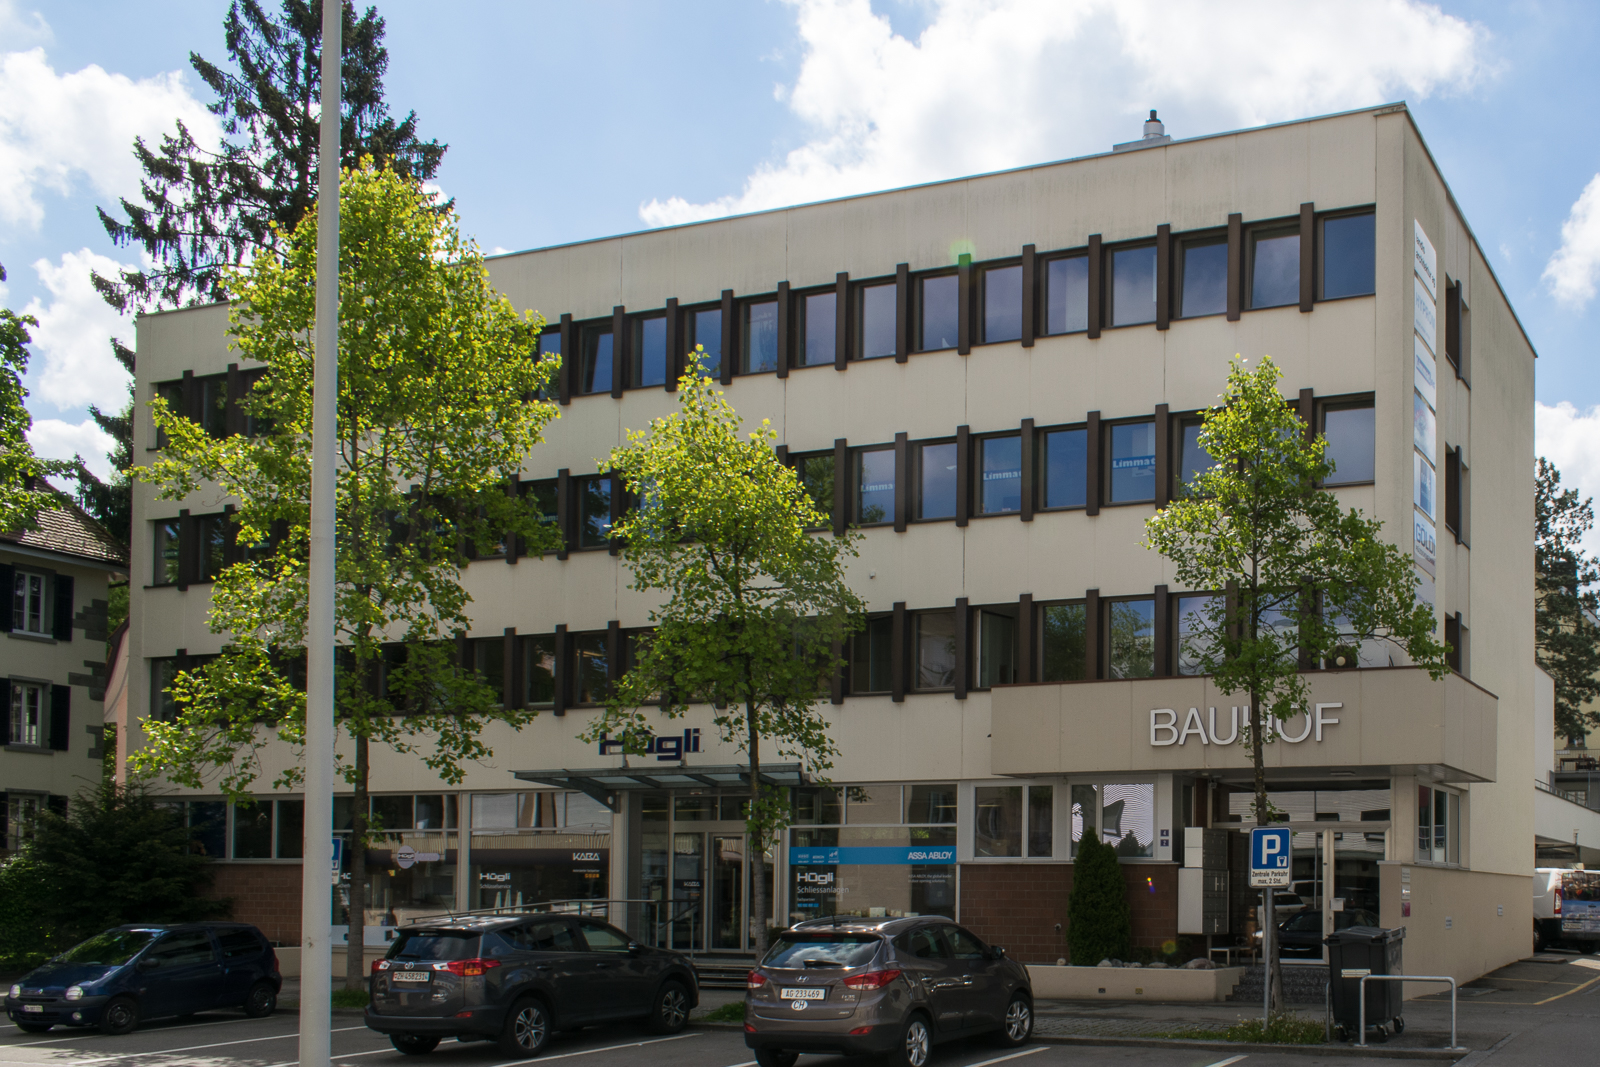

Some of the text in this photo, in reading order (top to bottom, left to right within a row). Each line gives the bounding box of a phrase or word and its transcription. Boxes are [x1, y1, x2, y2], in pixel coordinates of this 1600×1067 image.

[1150, 702, 1343, 746] BAUHOF
[1262, 834, 1281, 865] P
[572, 852, 600, 861] KABA
[907, 851, 953, 860] ASSA ABLOY
[797, 885, 850, 895] Schliessanlagen
[785, 989, 820, 998] AG 233469
[793, 1001, 806, 1010] CH
